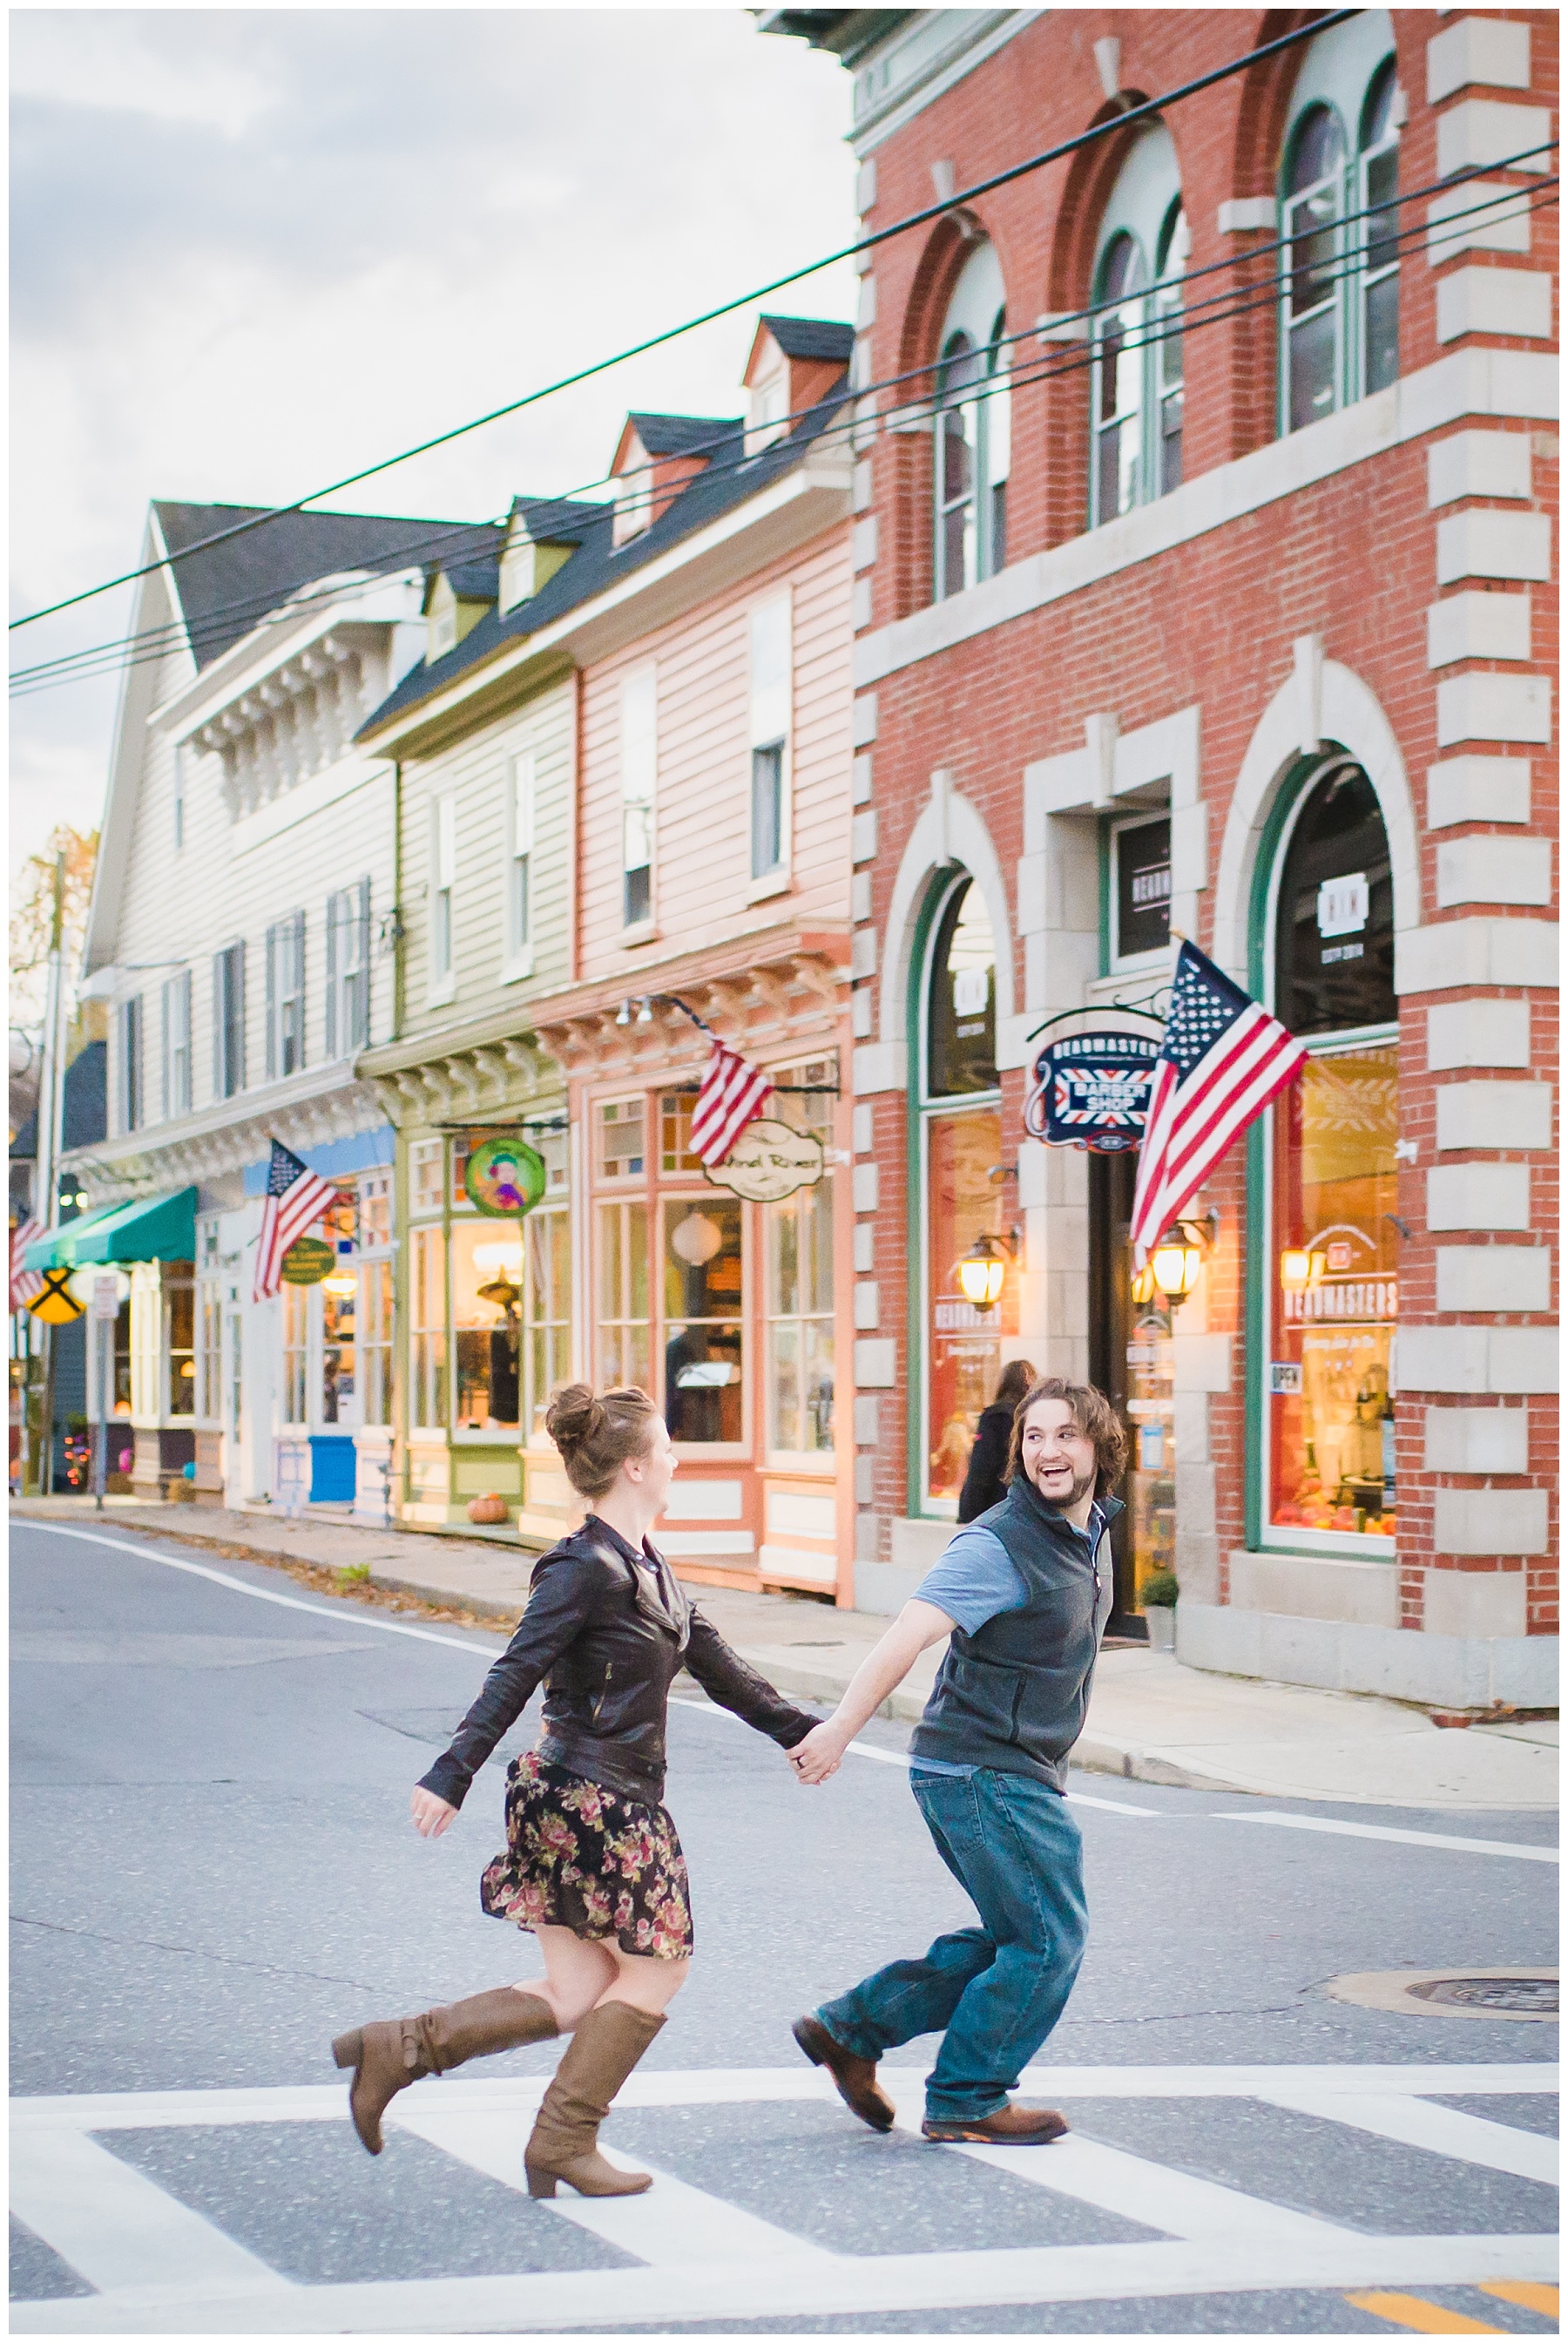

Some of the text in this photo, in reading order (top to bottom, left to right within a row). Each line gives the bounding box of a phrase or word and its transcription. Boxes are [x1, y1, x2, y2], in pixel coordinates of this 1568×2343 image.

[1073, 1082, 1146, 1099] BARBER
[1086, 1096, 1136, 1112] SHOP
[1272, 1365, 1299, 1390] OPEN
